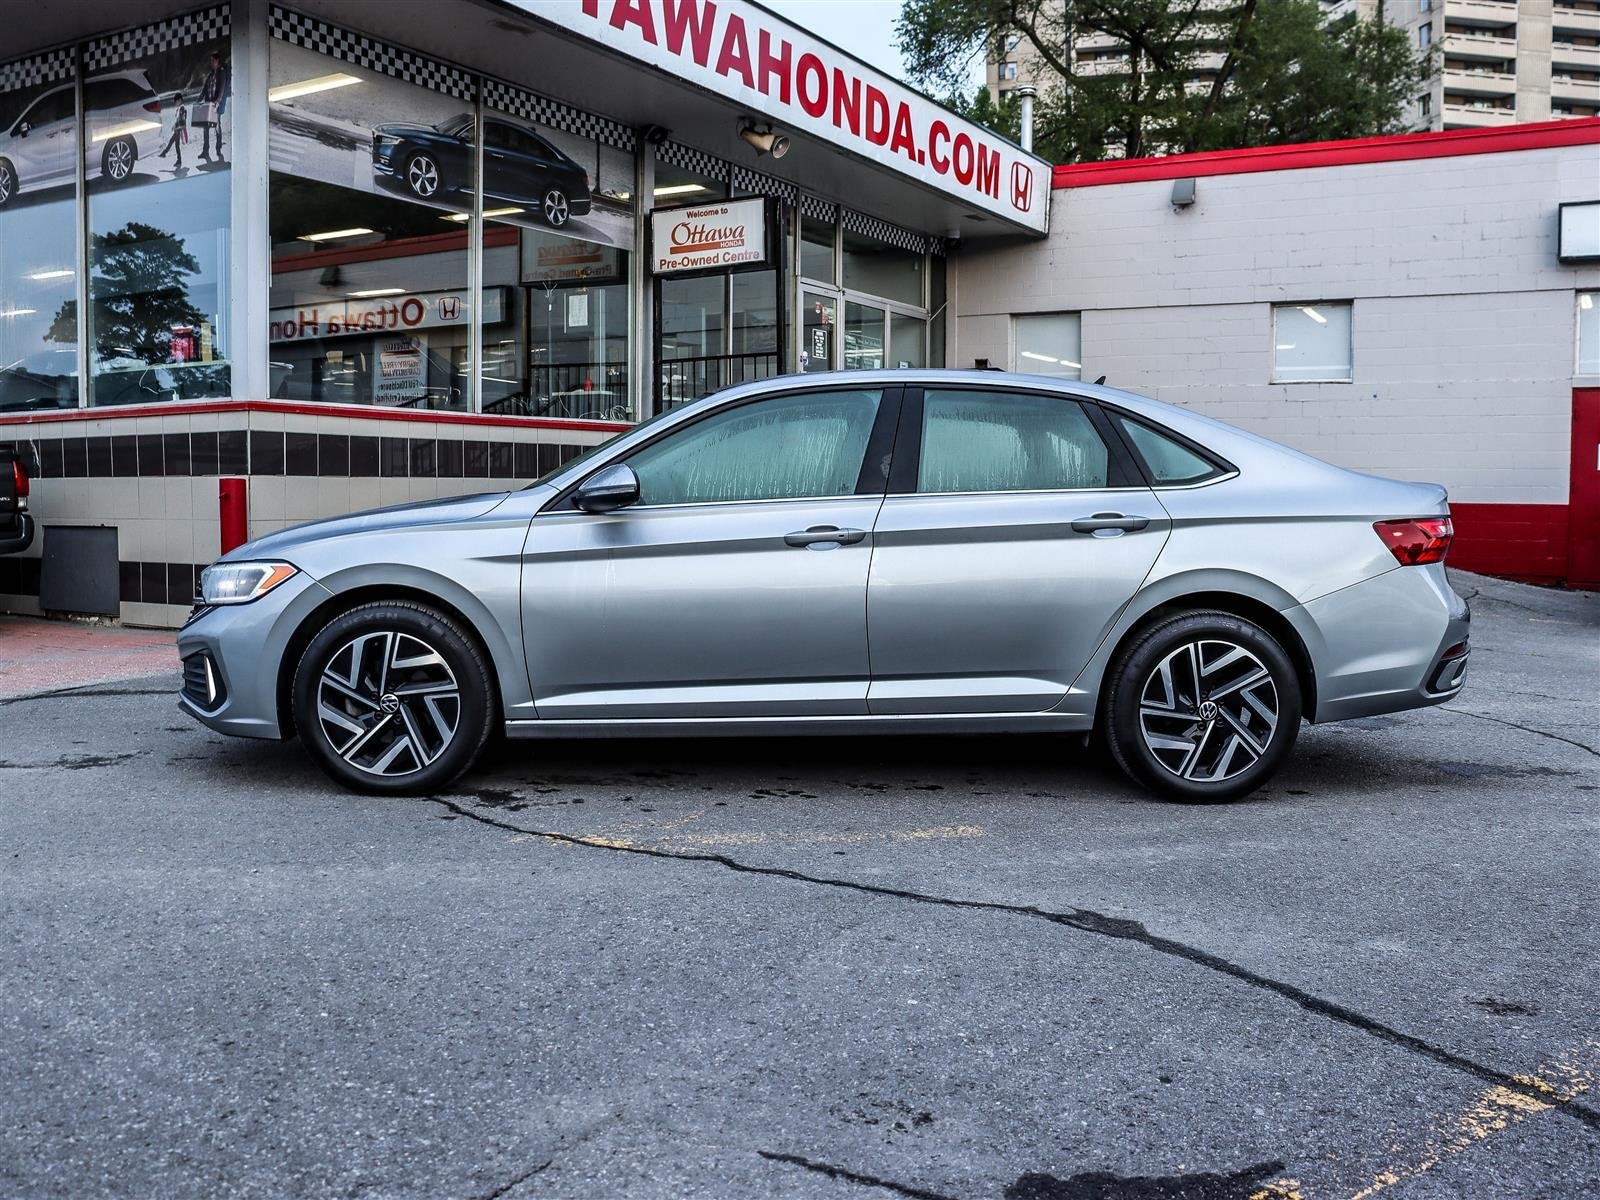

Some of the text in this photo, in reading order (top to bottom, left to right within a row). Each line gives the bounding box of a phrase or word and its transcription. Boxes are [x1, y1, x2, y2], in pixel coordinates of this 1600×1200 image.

[581, 0, 1001, 200] AWAHONDA.COM
[686, 207, 728, 219] Welcome to
[671, 222, 745, 246] Ottawa
[720, 239, 744, 248] HONDA
[660, 249, 760, 270] Pre-Owned Centre
